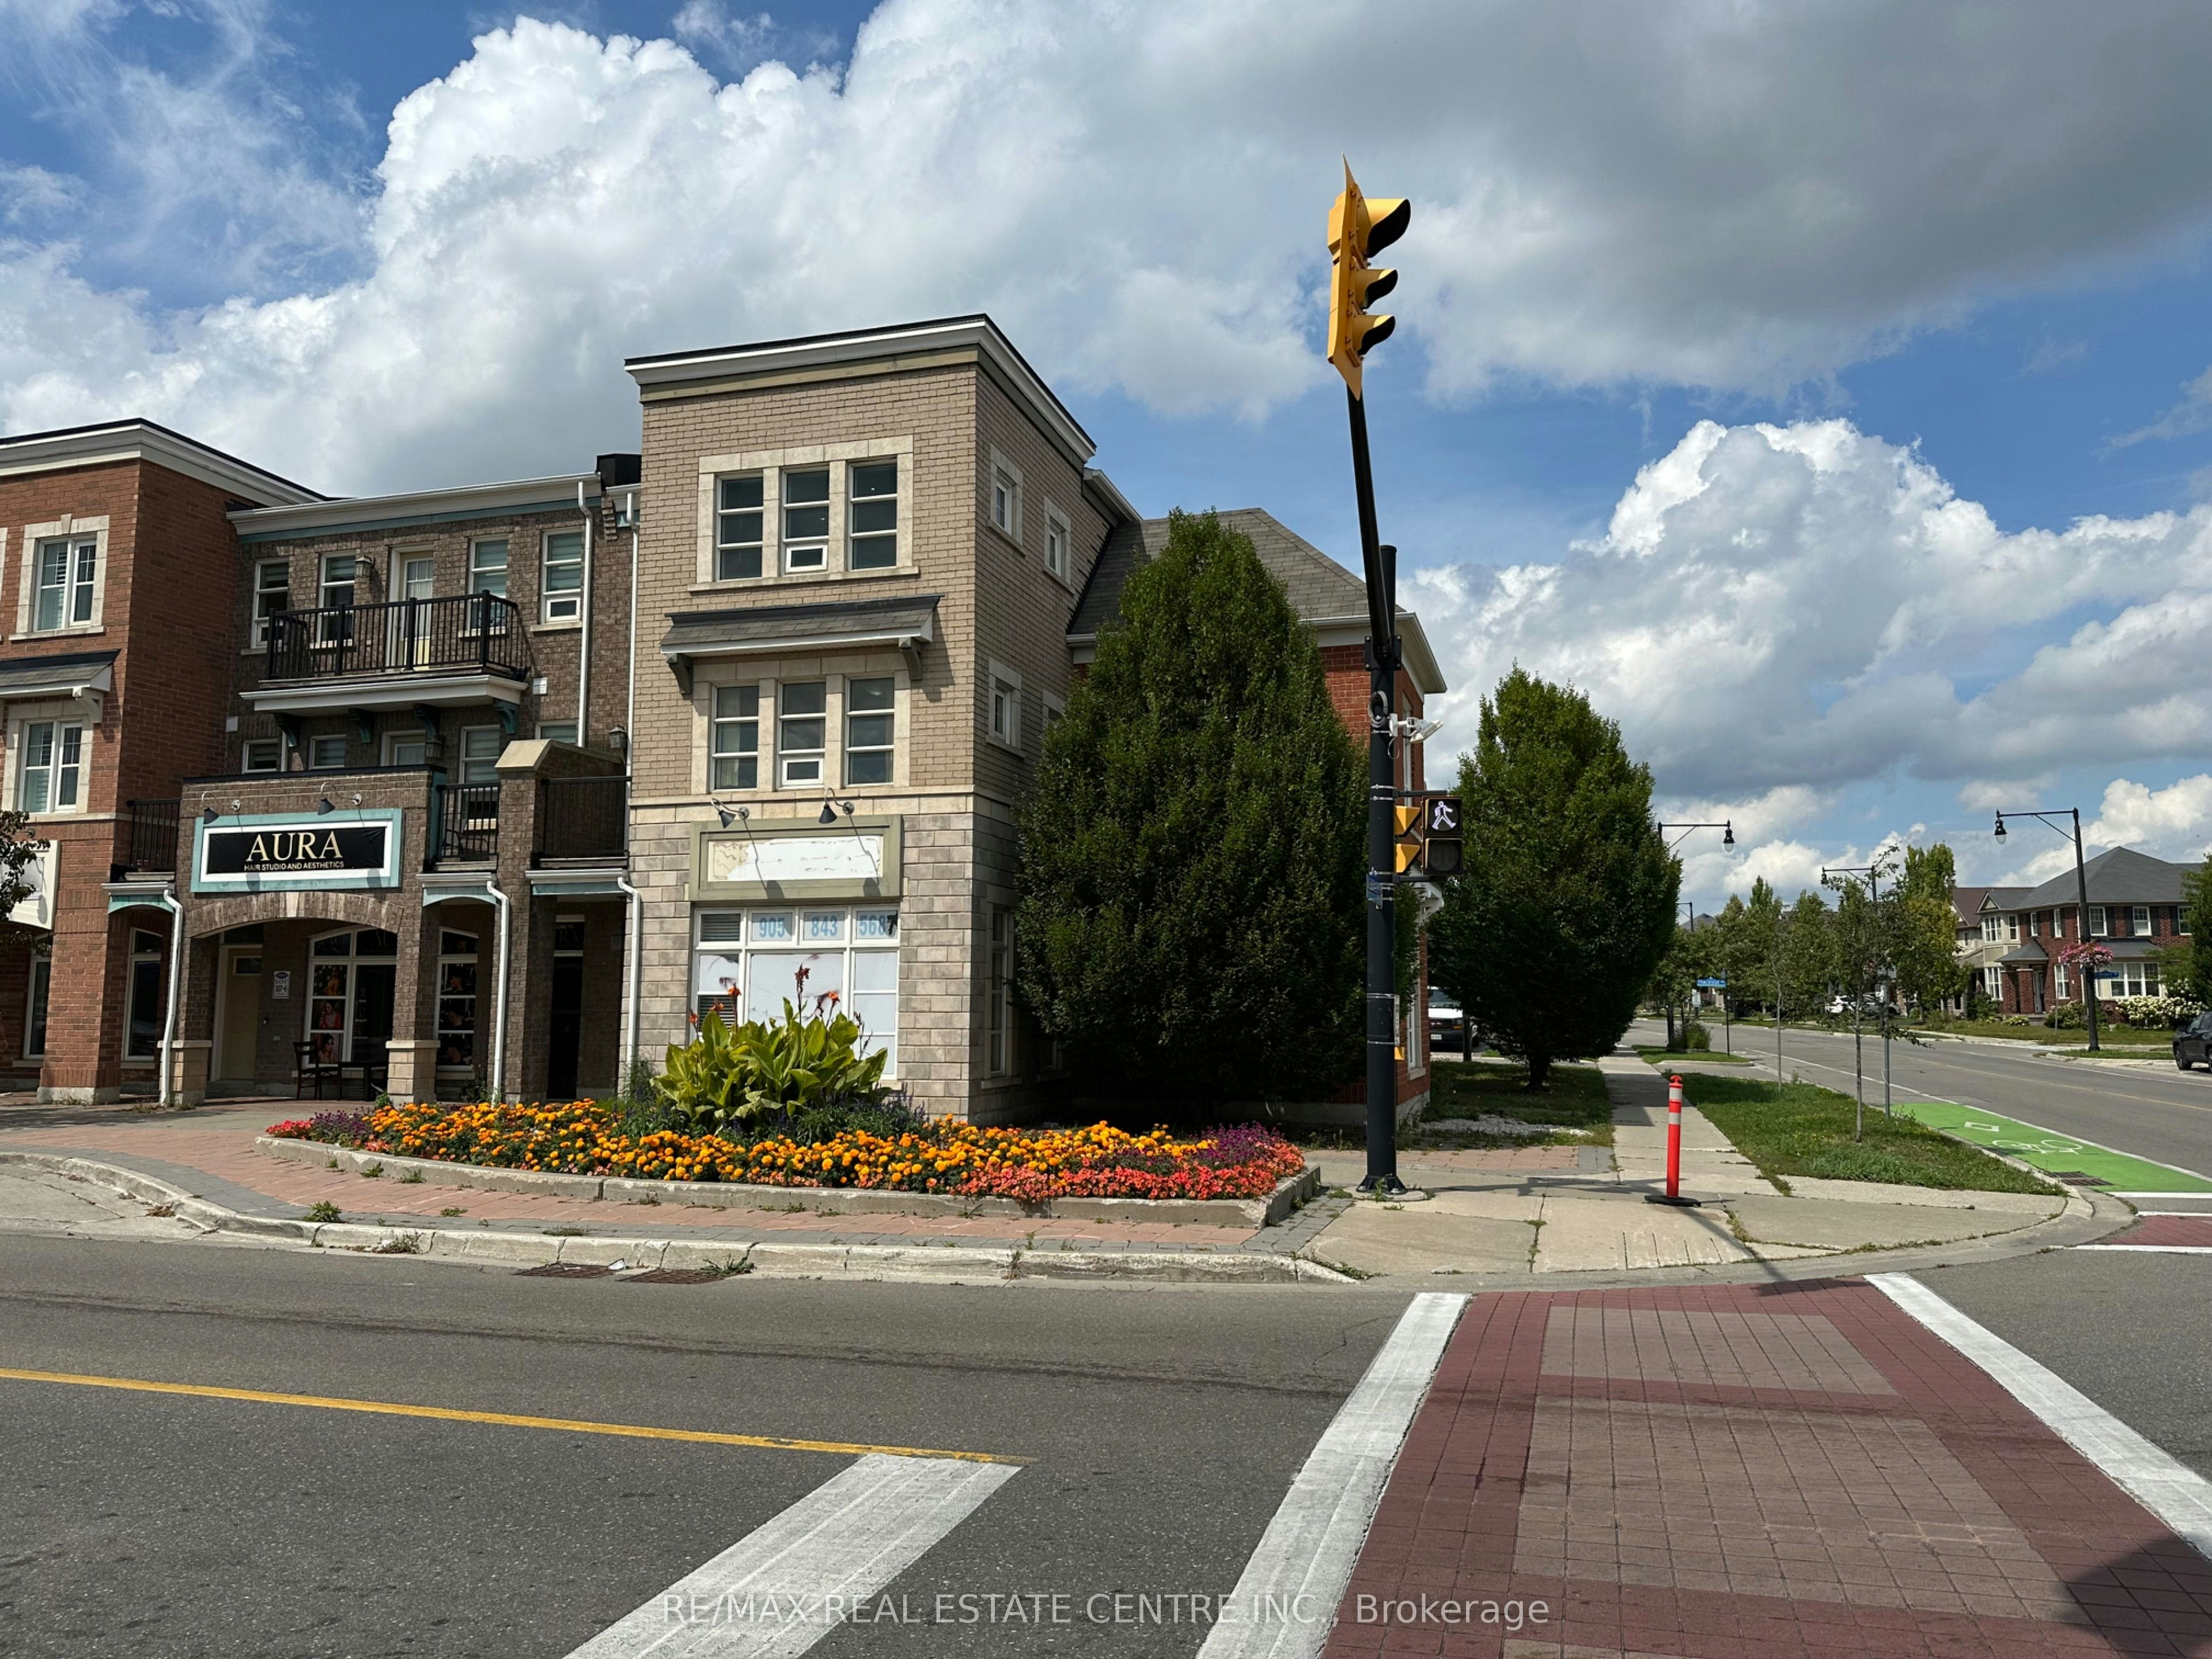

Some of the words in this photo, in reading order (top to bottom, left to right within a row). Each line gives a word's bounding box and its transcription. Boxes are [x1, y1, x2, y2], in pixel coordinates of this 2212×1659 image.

[245, 831, 343, 862] AURA
[303, 861, 344, 870] AESTHETICS
[759, 916, 785, 937] 905
[811, 915, 838, 937] 843
